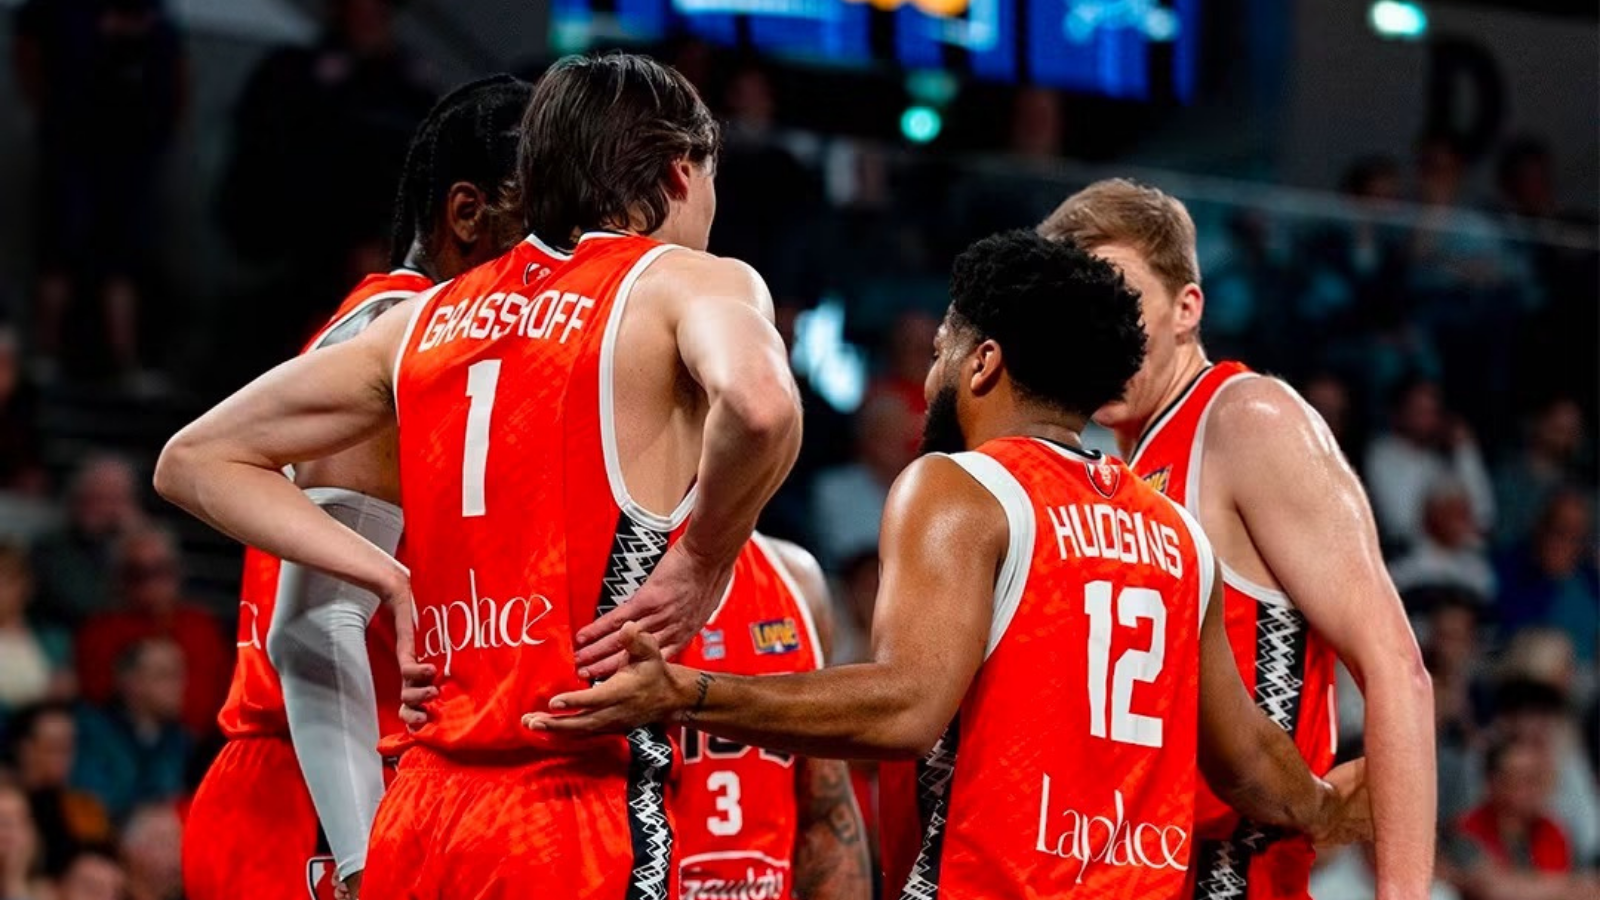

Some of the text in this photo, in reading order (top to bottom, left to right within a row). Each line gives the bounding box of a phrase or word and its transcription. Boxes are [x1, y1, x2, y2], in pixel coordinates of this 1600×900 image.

[462, 359, 502, 517] 1
[1047, 503, 1184, 579] HUDGINS
[1083, 580, 1168, 749] 12
[706, 770, 743, 836] 3
[1035, 772, 1189, 884] Laplace
